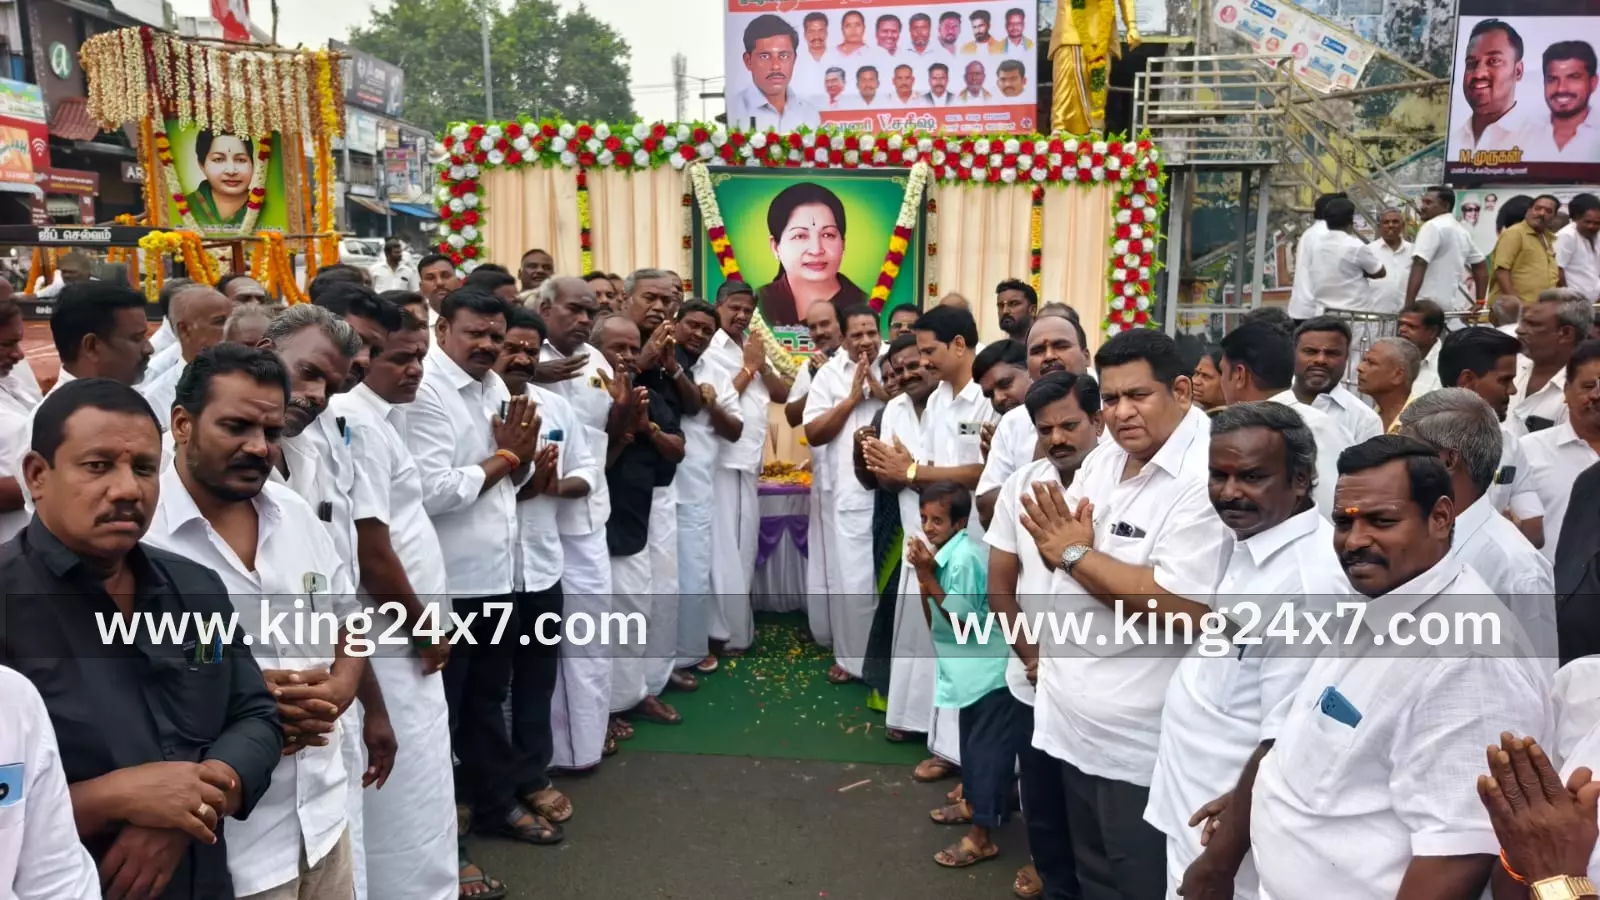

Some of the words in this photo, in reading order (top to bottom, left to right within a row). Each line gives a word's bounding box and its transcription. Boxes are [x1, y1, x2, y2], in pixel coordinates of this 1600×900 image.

[1459, 145, 1524, 166] M.முருகன்
[127, 165, 145, 179] AR
[63, 228, 112, 241] செல்வம்
